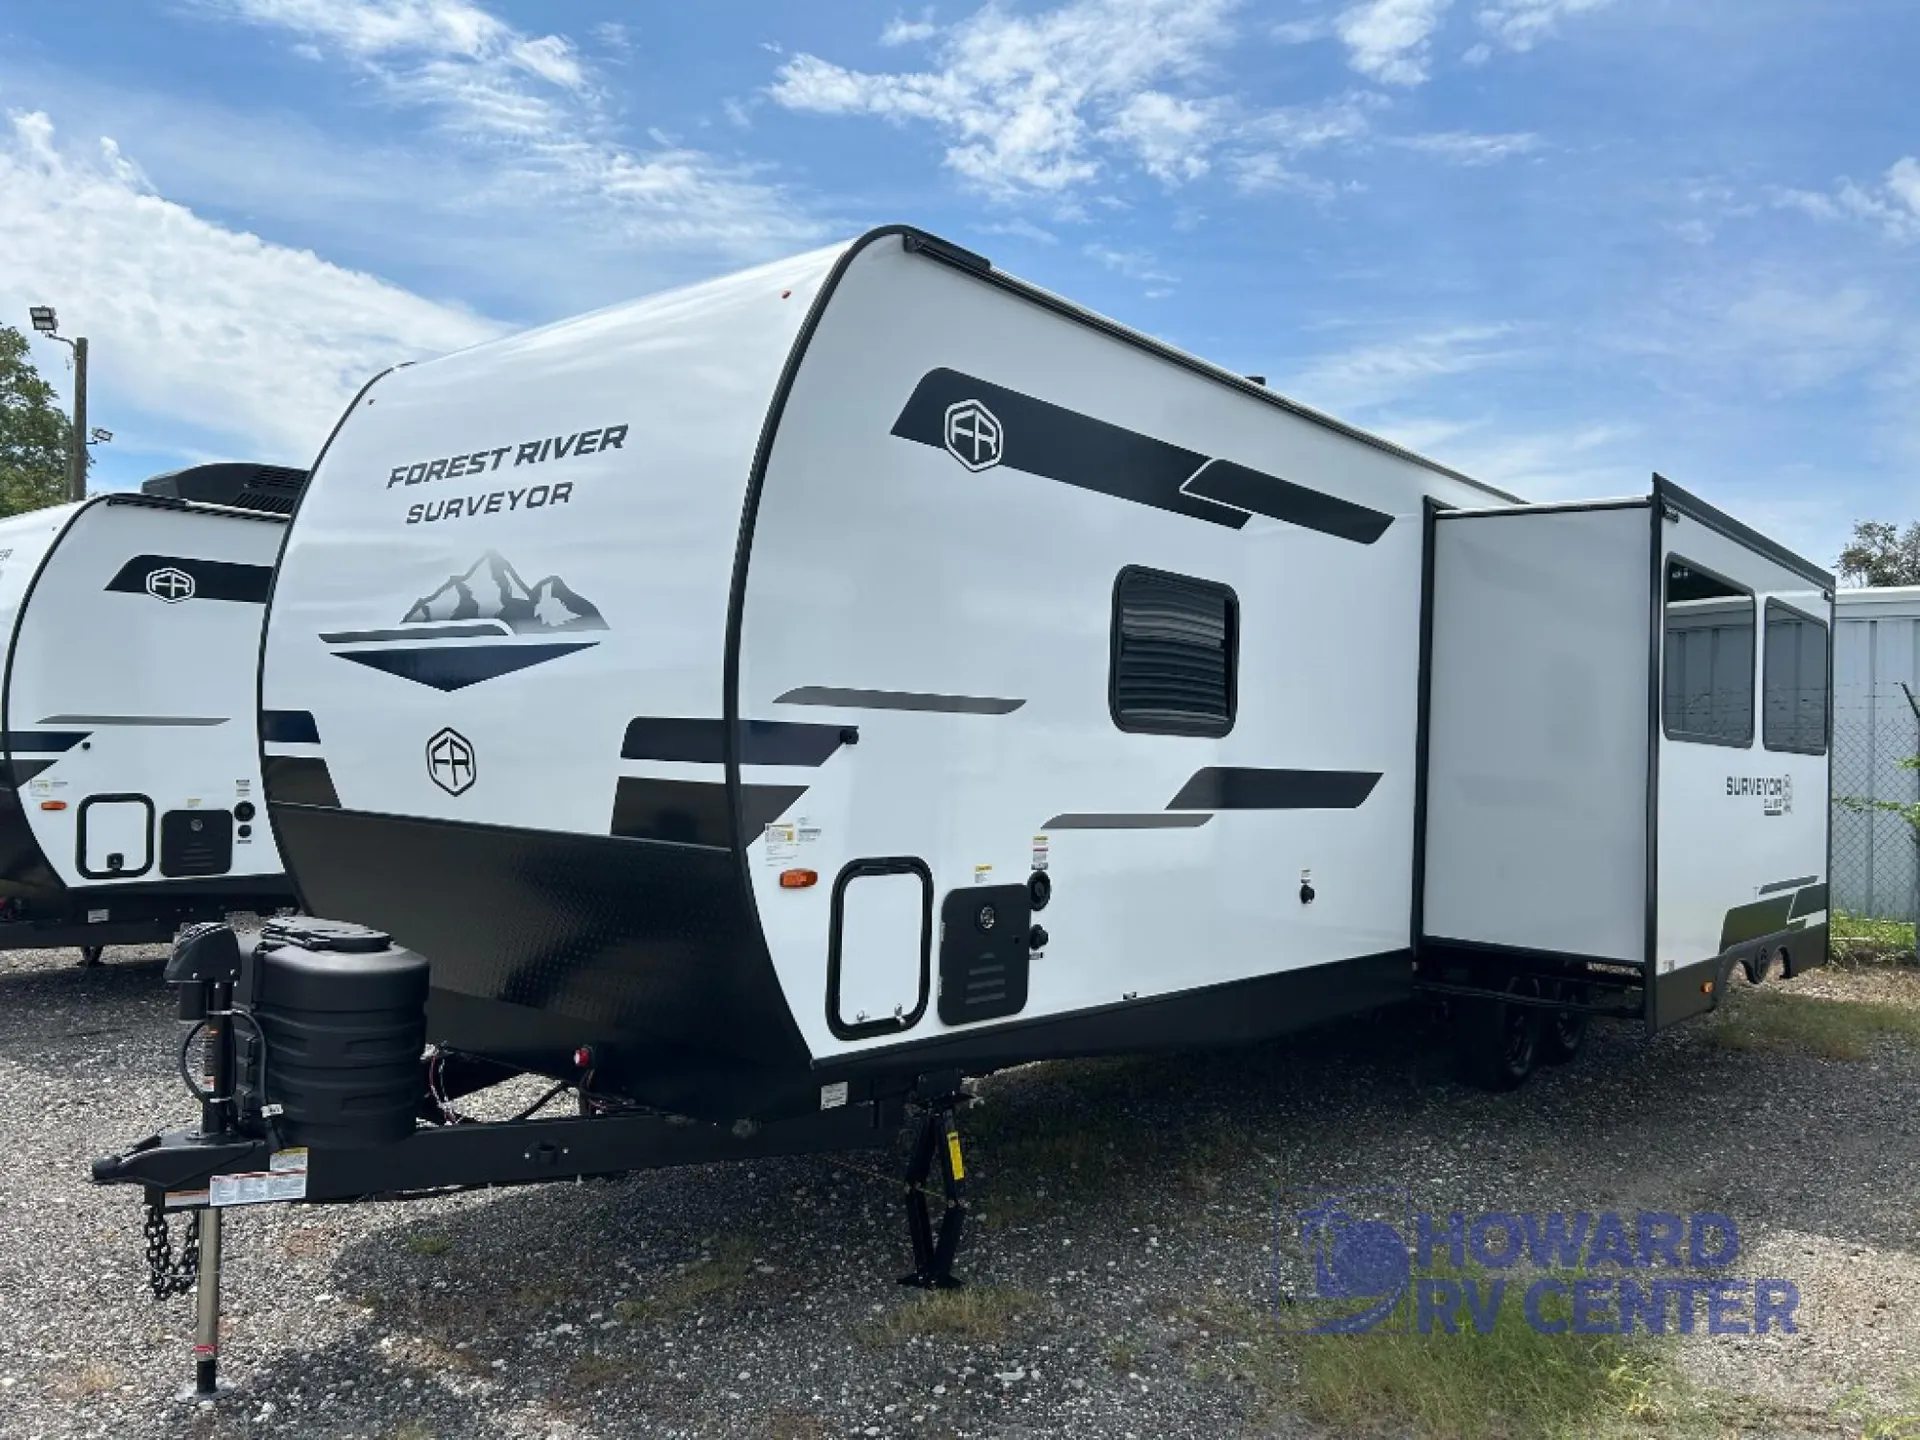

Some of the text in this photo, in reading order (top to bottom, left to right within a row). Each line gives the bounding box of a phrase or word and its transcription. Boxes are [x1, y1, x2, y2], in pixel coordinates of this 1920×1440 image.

[387, 423, 629, 489] FOREST RIVER
[406, 481, 573, 524] SURVEYOR
[1726, 776, 1782, 796] SURVEYOR
